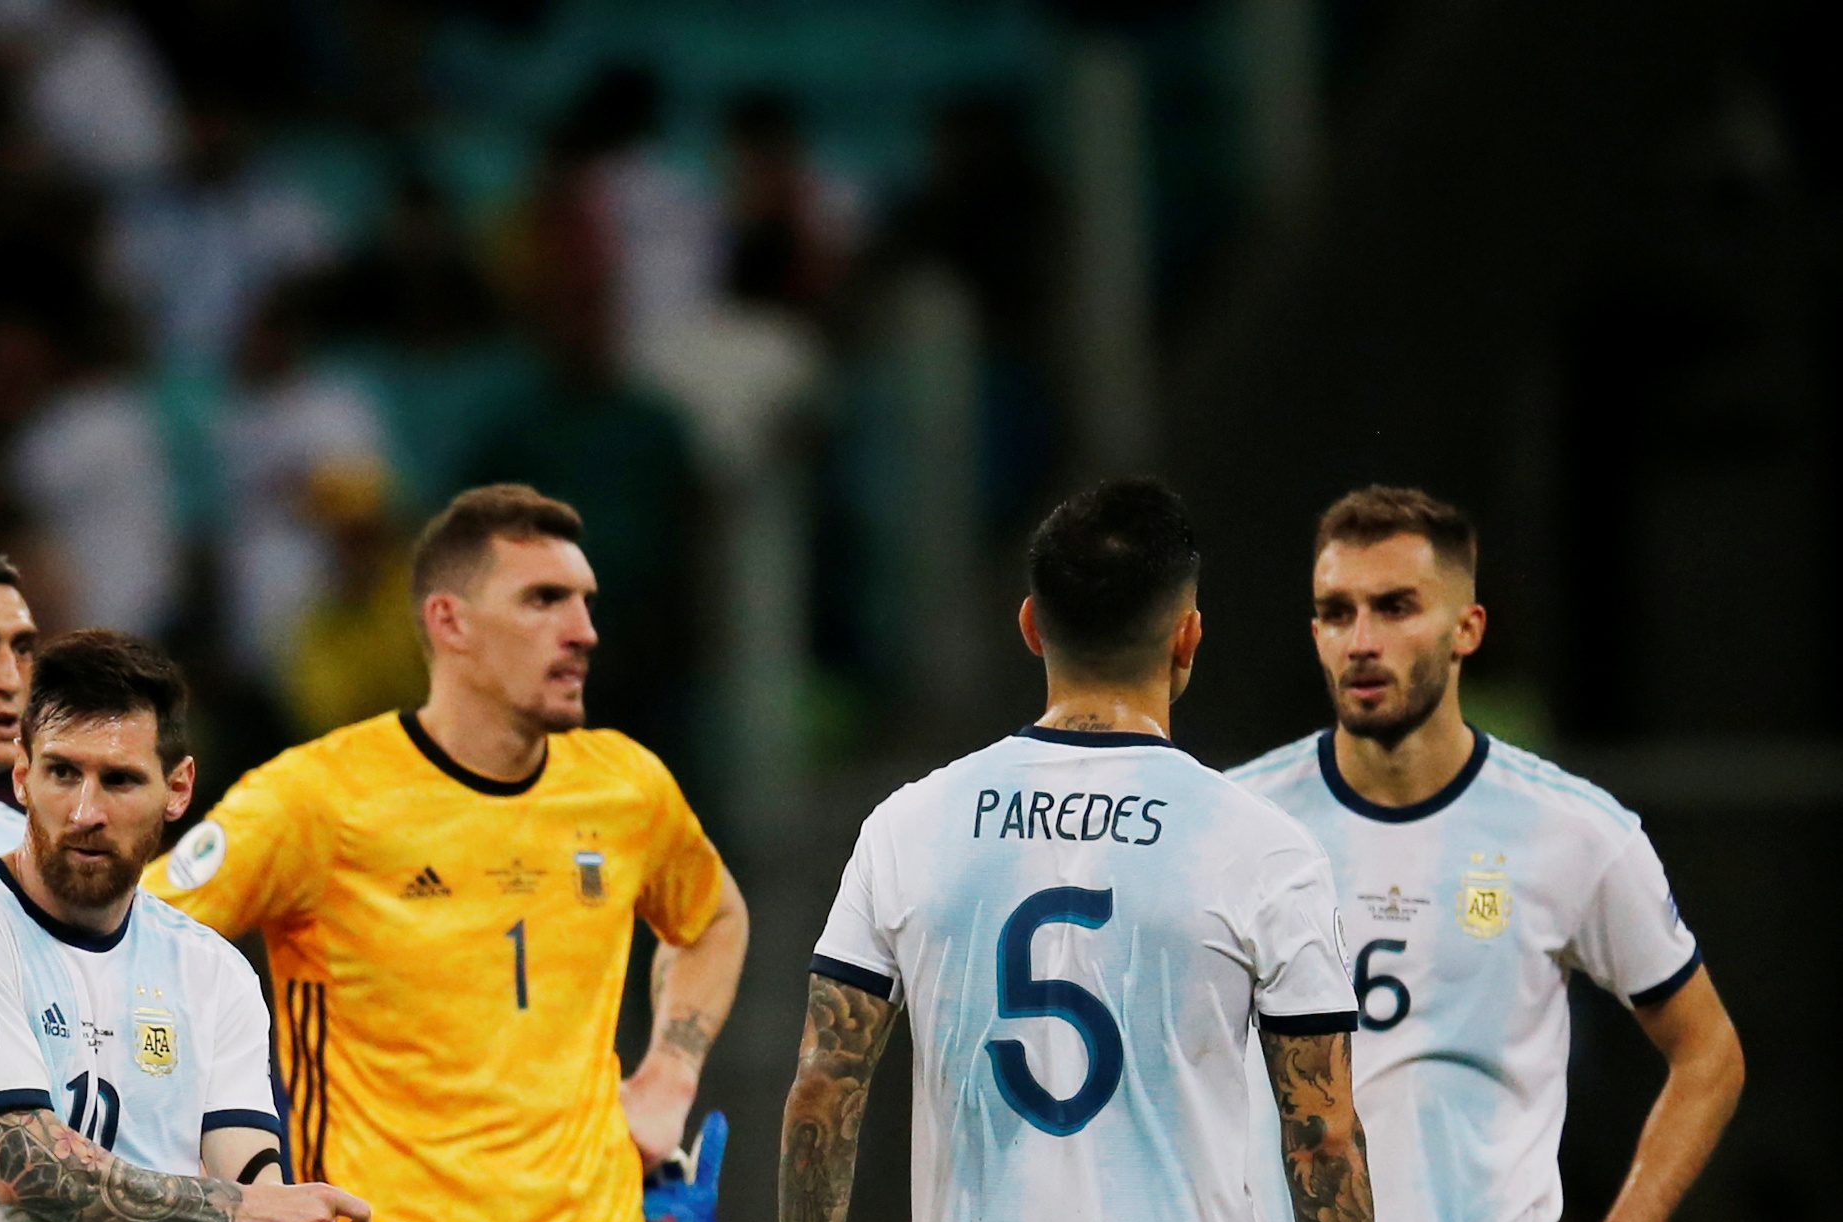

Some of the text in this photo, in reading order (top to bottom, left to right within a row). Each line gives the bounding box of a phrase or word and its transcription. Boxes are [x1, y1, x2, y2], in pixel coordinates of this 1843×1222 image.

[973, 789, 1168, 846] PAREDES
[506, 919, 528, 1010] 1
[1354, 938, 1411, 1031] 6
[143, 1026, 171, 1058] AFA
[984, 885, 1124, 1138] 5
[66, 1070, 120, 1152] 10
